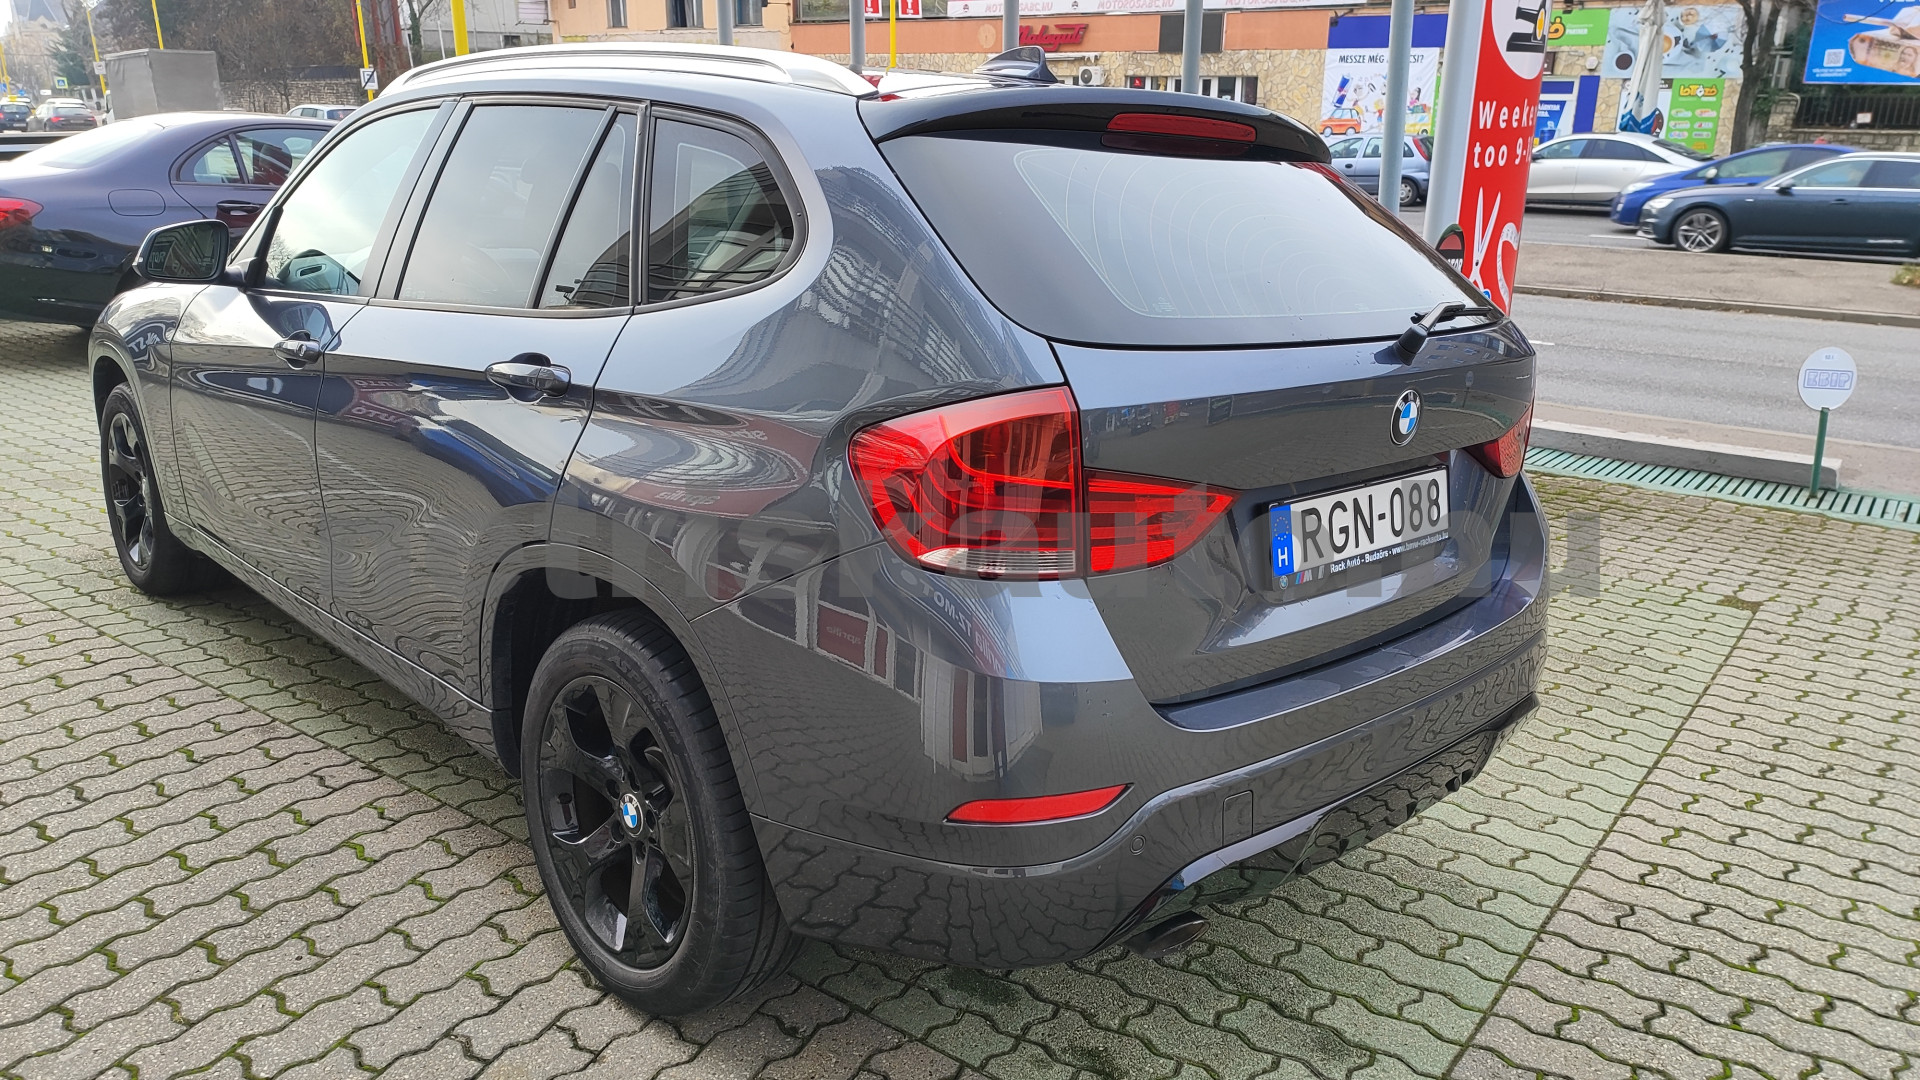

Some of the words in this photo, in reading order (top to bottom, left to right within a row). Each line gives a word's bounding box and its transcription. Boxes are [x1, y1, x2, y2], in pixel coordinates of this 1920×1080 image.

[1338, 54, 1367, 64] MESSZE
[1367, 53, 1385, 63] MÉG
[1473, 141, 1508, 169] too
[1301, 478, 1441, 563] RGN-088
[1277, 546, 1289, 568] H
[1330, 562, 1346, 574] Rack
